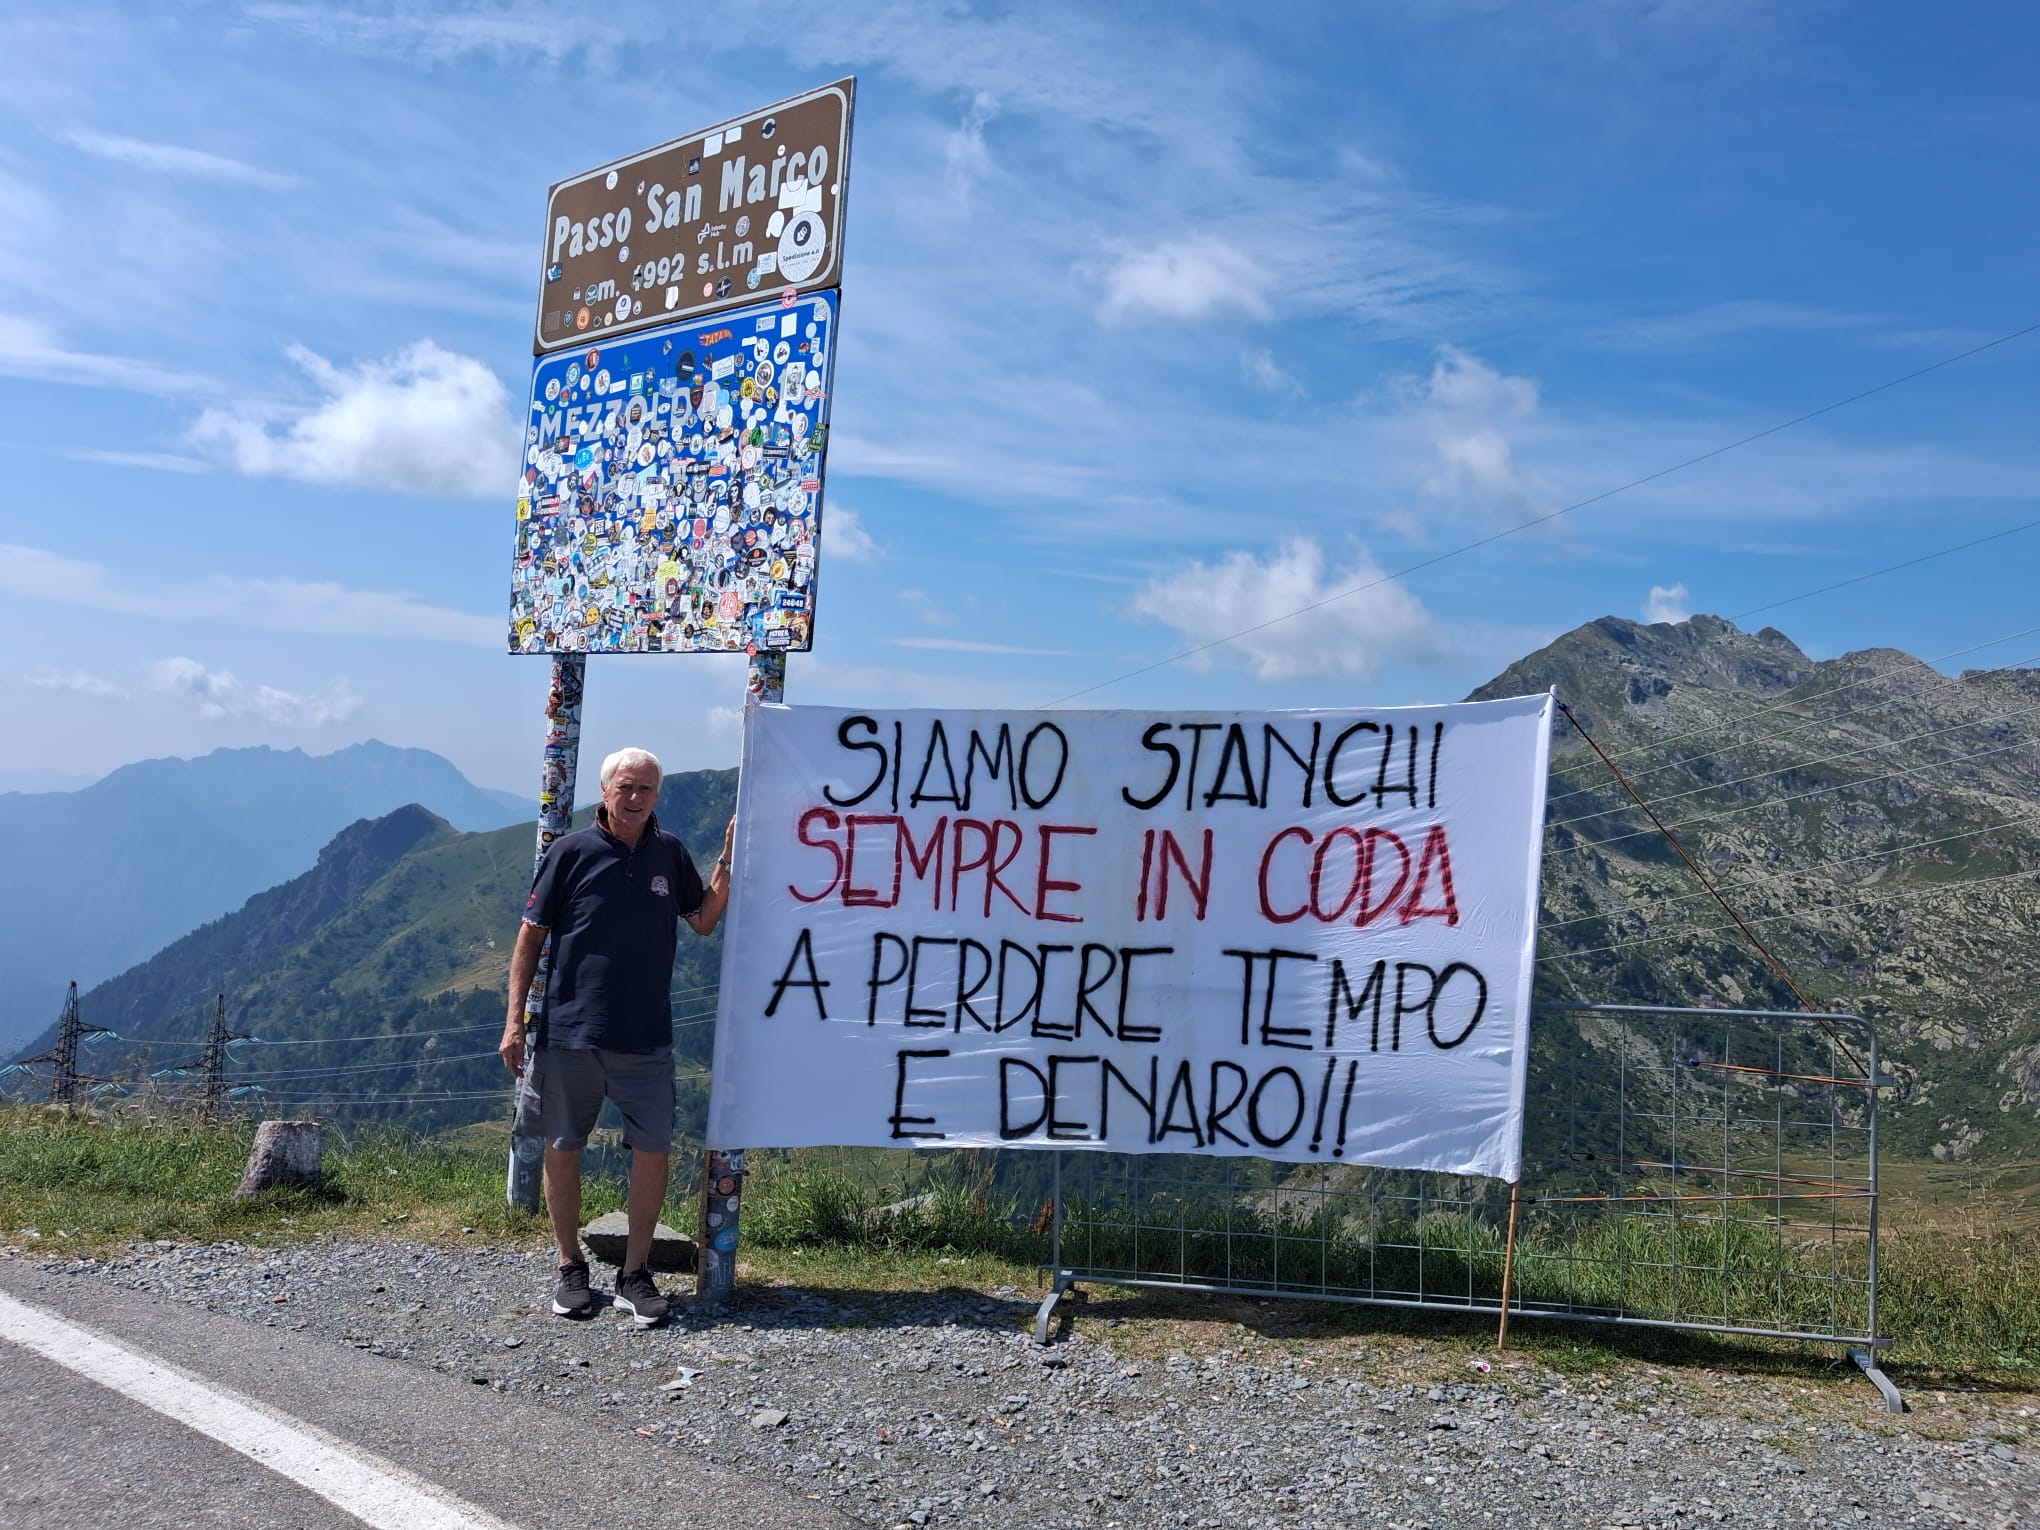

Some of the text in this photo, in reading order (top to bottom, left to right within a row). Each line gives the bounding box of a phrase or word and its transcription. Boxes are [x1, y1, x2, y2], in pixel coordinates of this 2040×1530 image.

[552, 145, 829, 264] Passo San Marco
[597, 278, 620, 302] m.
[696, 241, 754, 275] s.l.m
[824, 715, 1444, 812] SIAMO STANCHI
[788, 807, 1461, 928] SEMPRE IN CODA
[763, 928, 1488, 1053] A PERDERE TEMPO
[888, 1048, 1358, 1159] E DENARO!!
